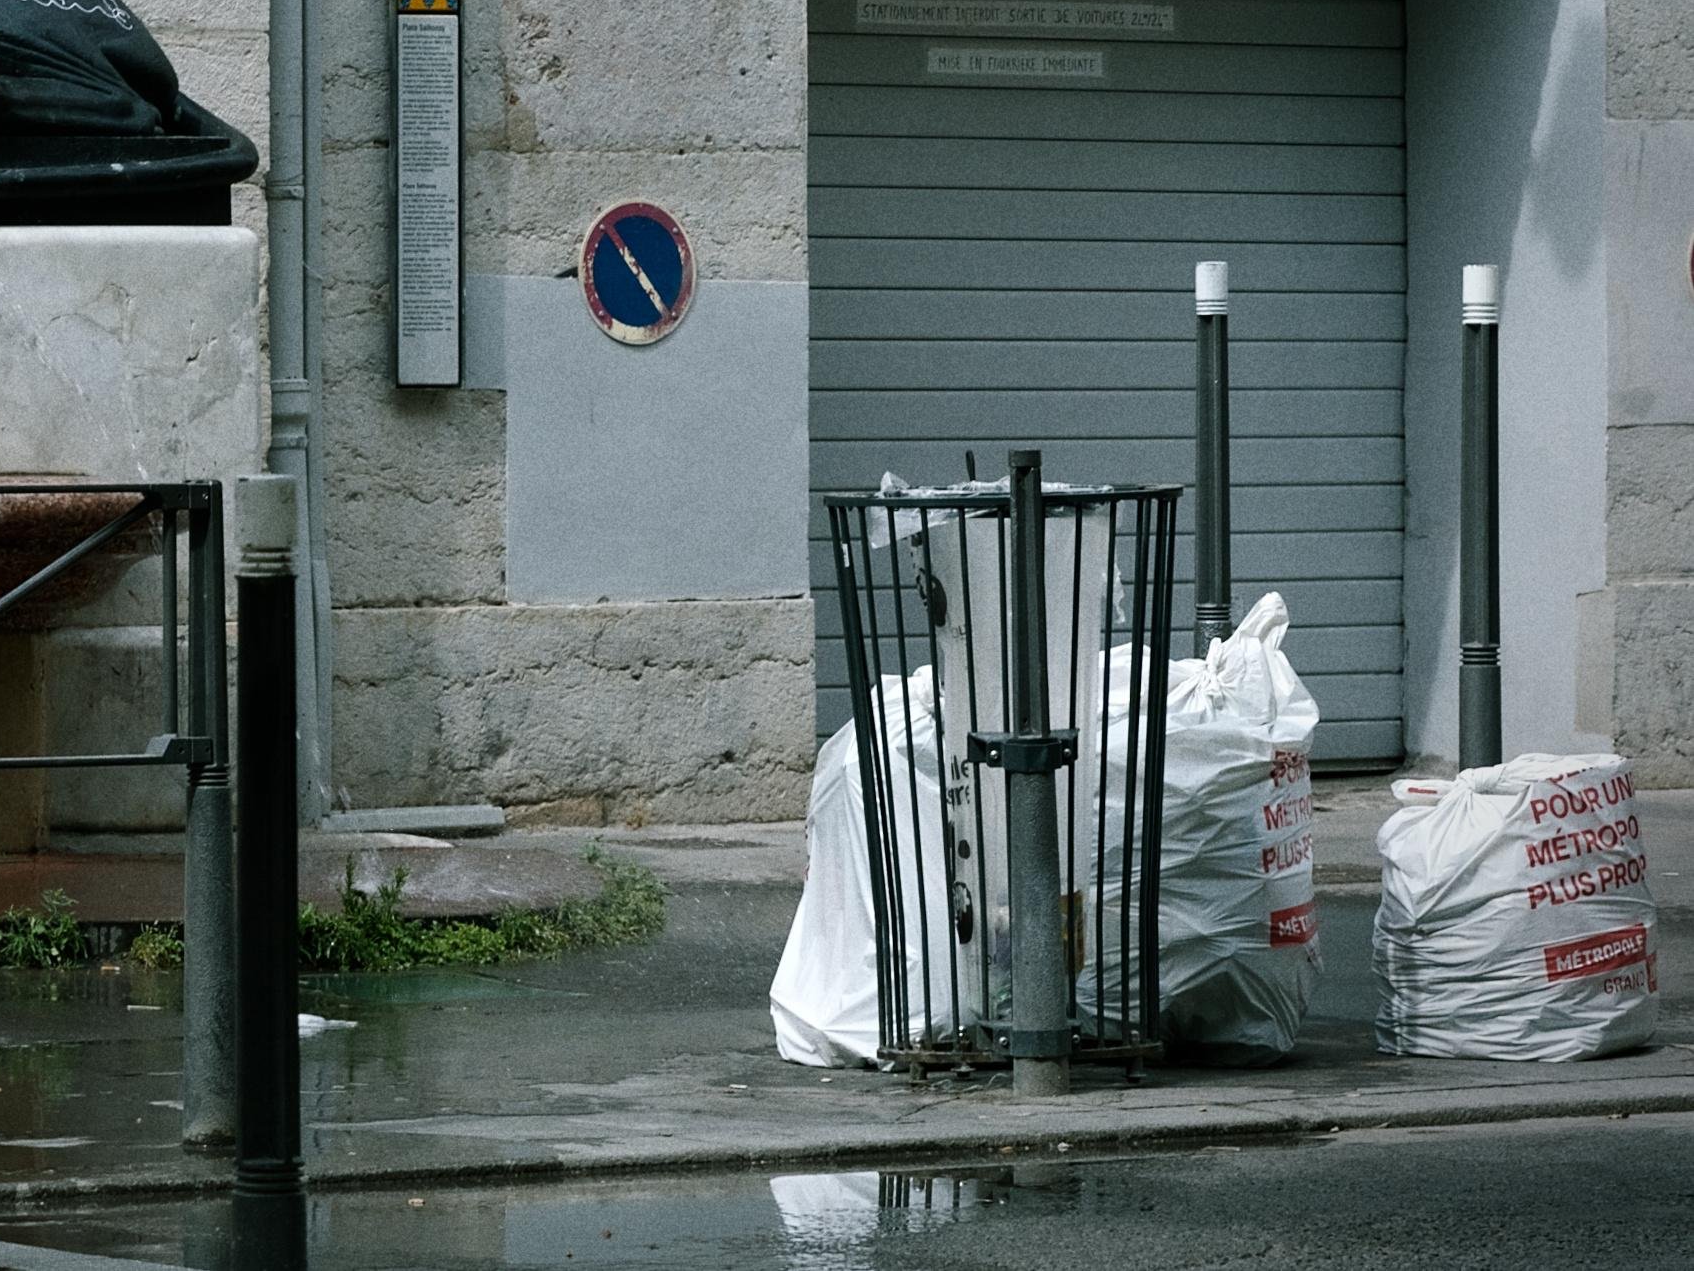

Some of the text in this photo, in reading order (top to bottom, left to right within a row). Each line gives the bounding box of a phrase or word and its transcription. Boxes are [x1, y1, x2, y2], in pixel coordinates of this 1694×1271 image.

[861, 3, 949, 21] STATIONNEMENT
[1530, 787, 1602, 824] POUR
[1527, 872, 1596, 910] PLUS
[1555, 934, 1644, 974] MÉTROPOLE
